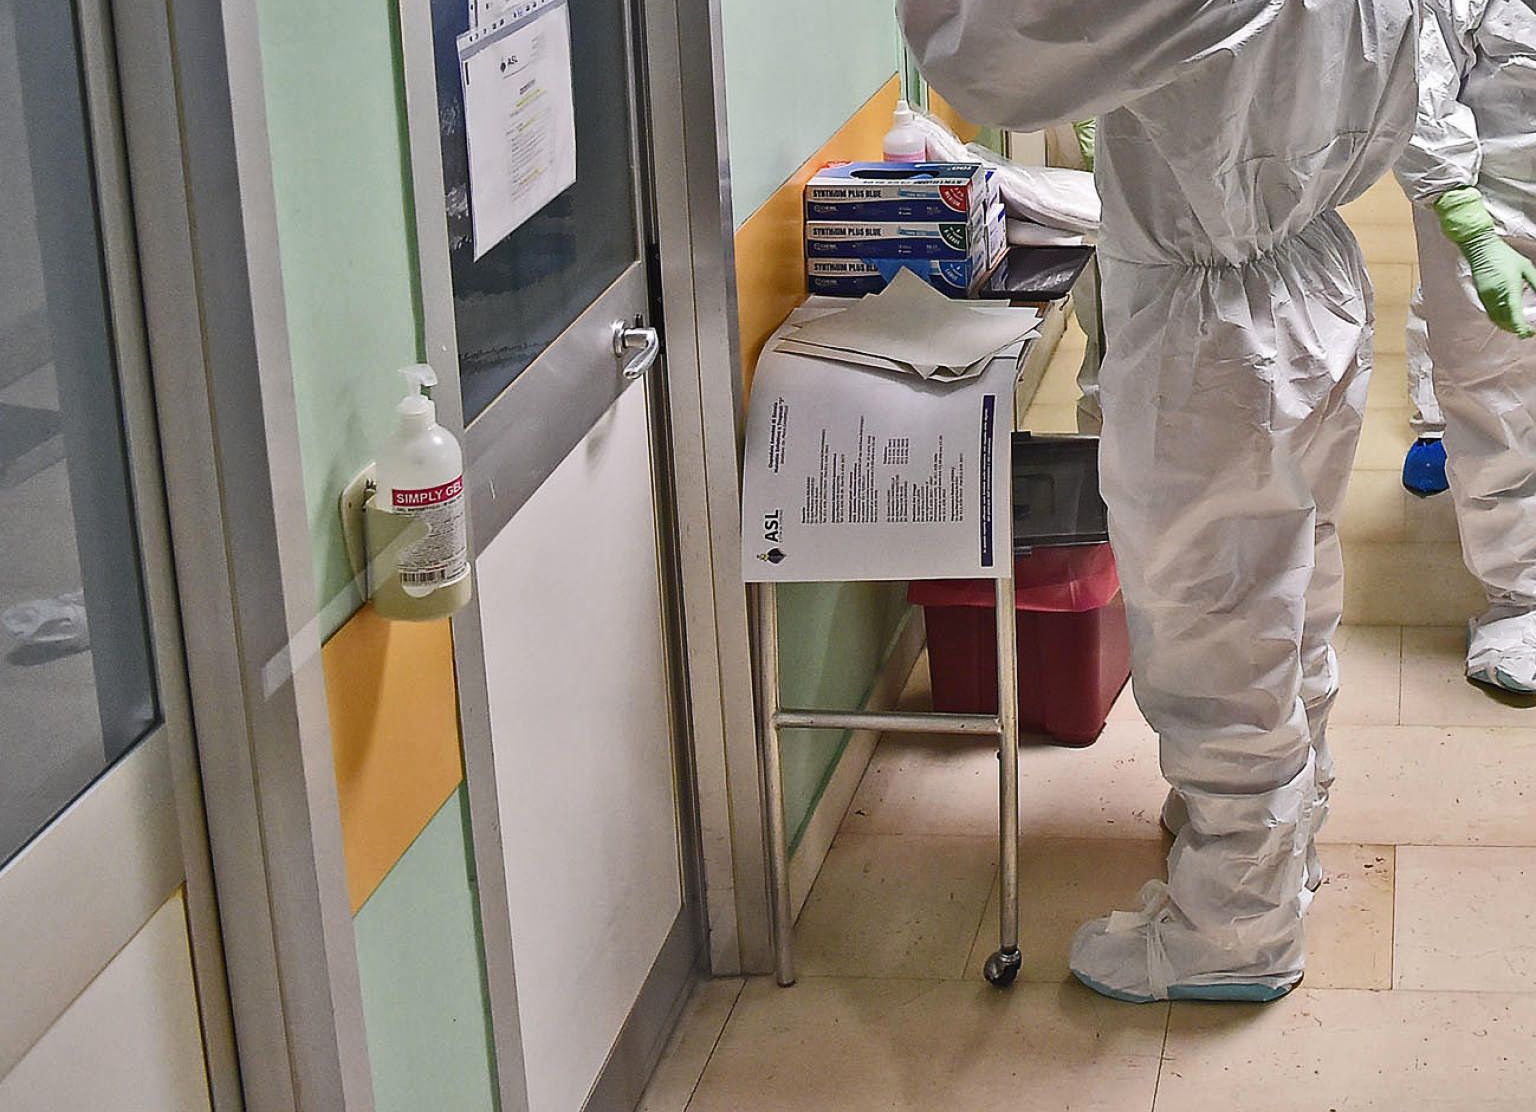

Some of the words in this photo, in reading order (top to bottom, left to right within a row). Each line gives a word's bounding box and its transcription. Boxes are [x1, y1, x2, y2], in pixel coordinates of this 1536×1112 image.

[848, 189, 864, 198] PLUS
[866, 189, 882, 198] BLUE
[848, 227, 864, 237] PLUS
[866, 227, 882, 237] BLUE
[849, 263, 865, 272] PLUS
[396, 490, 443, 503] SIMPLY
[446, 481, 462, 496] GEL
[764, 509, 779, 543] ASL
